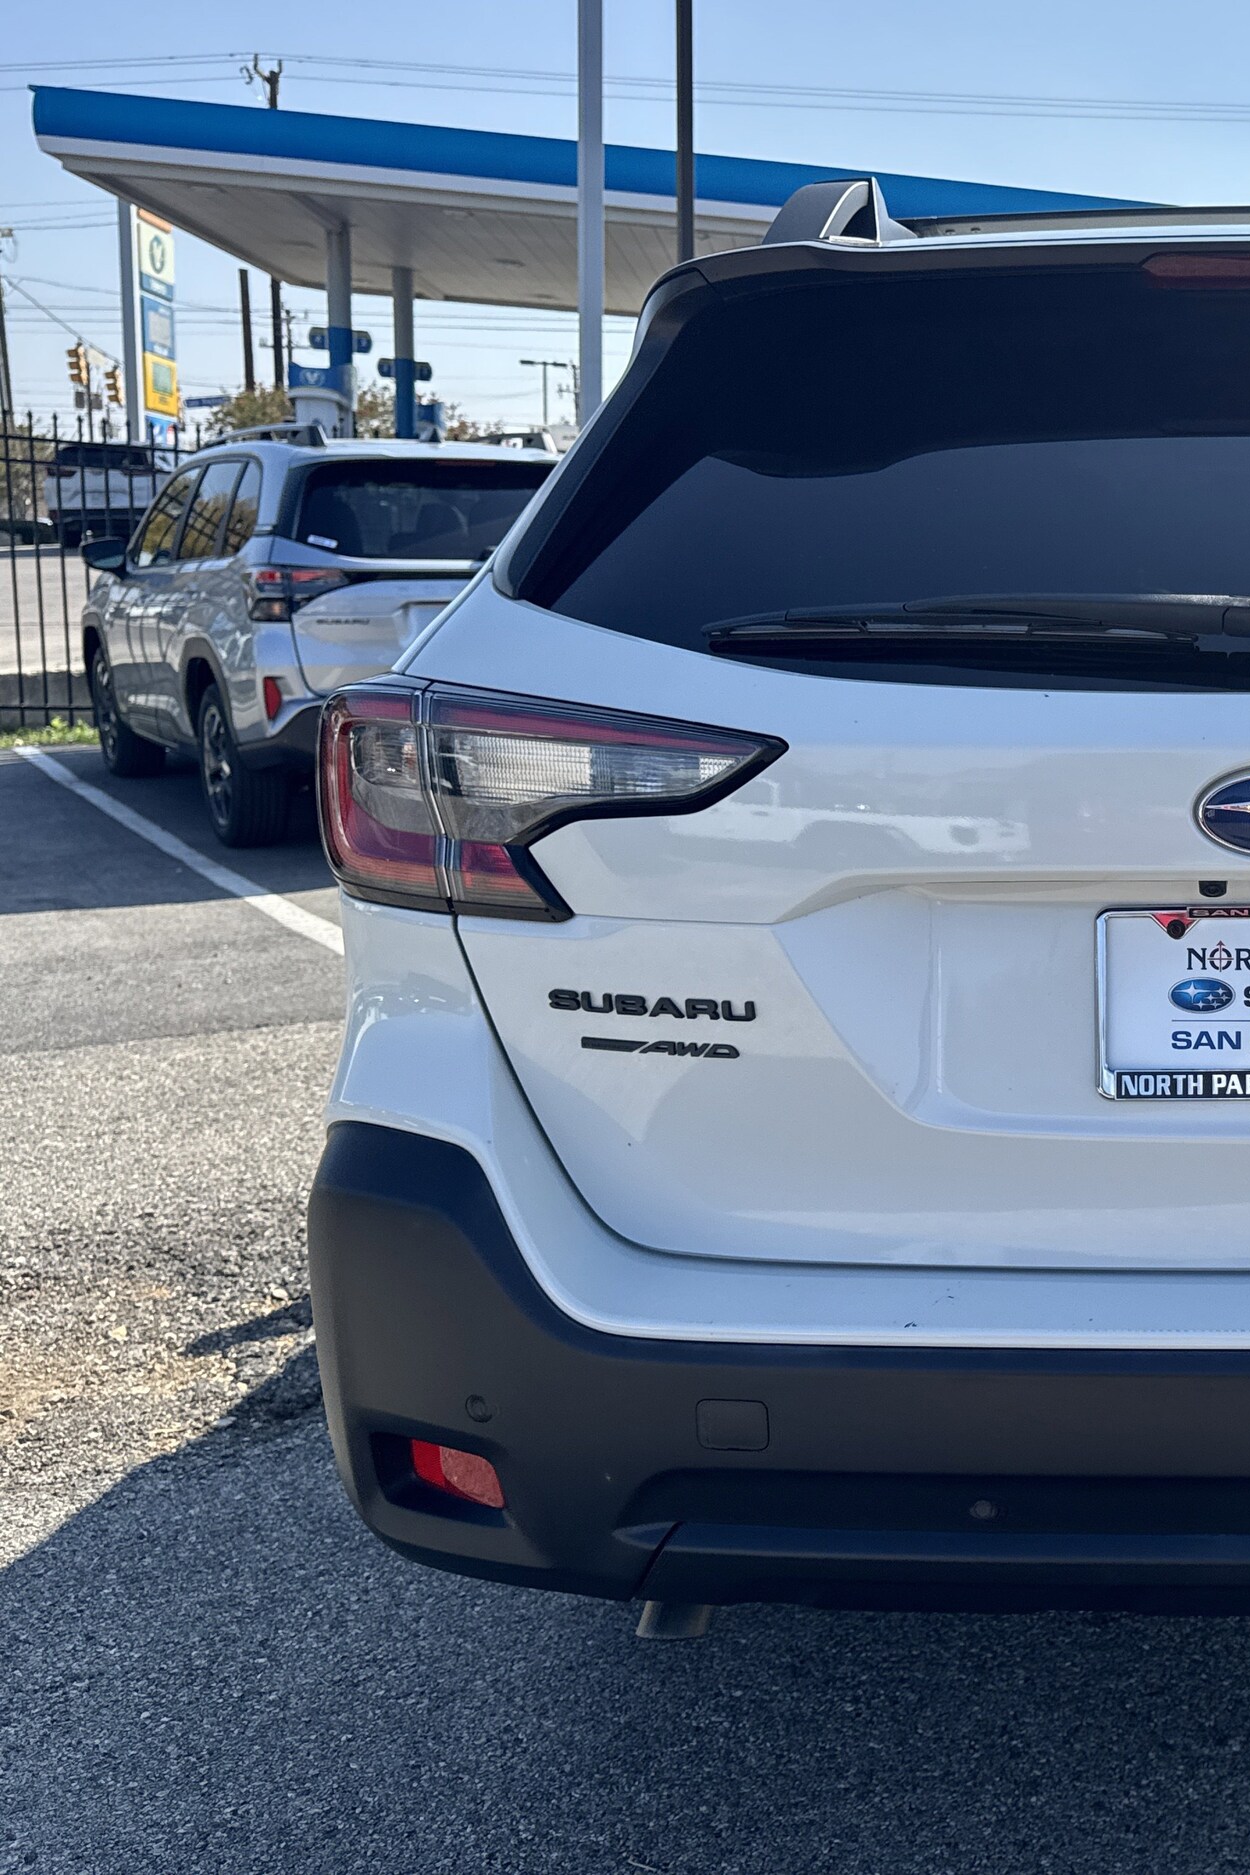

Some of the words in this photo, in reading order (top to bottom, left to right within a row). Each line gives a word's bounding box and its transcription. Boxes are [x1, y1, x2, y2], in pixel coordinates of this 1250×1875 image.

[1191, 909, 1249, 917] SAN
[548, 988, 757, 1022] SUBARU
[639, 1040, 740, 1059] AWD
[1171, 1030, 1242, 1050] SAN
[1121, 1073, 1203, 1096] NORTH
